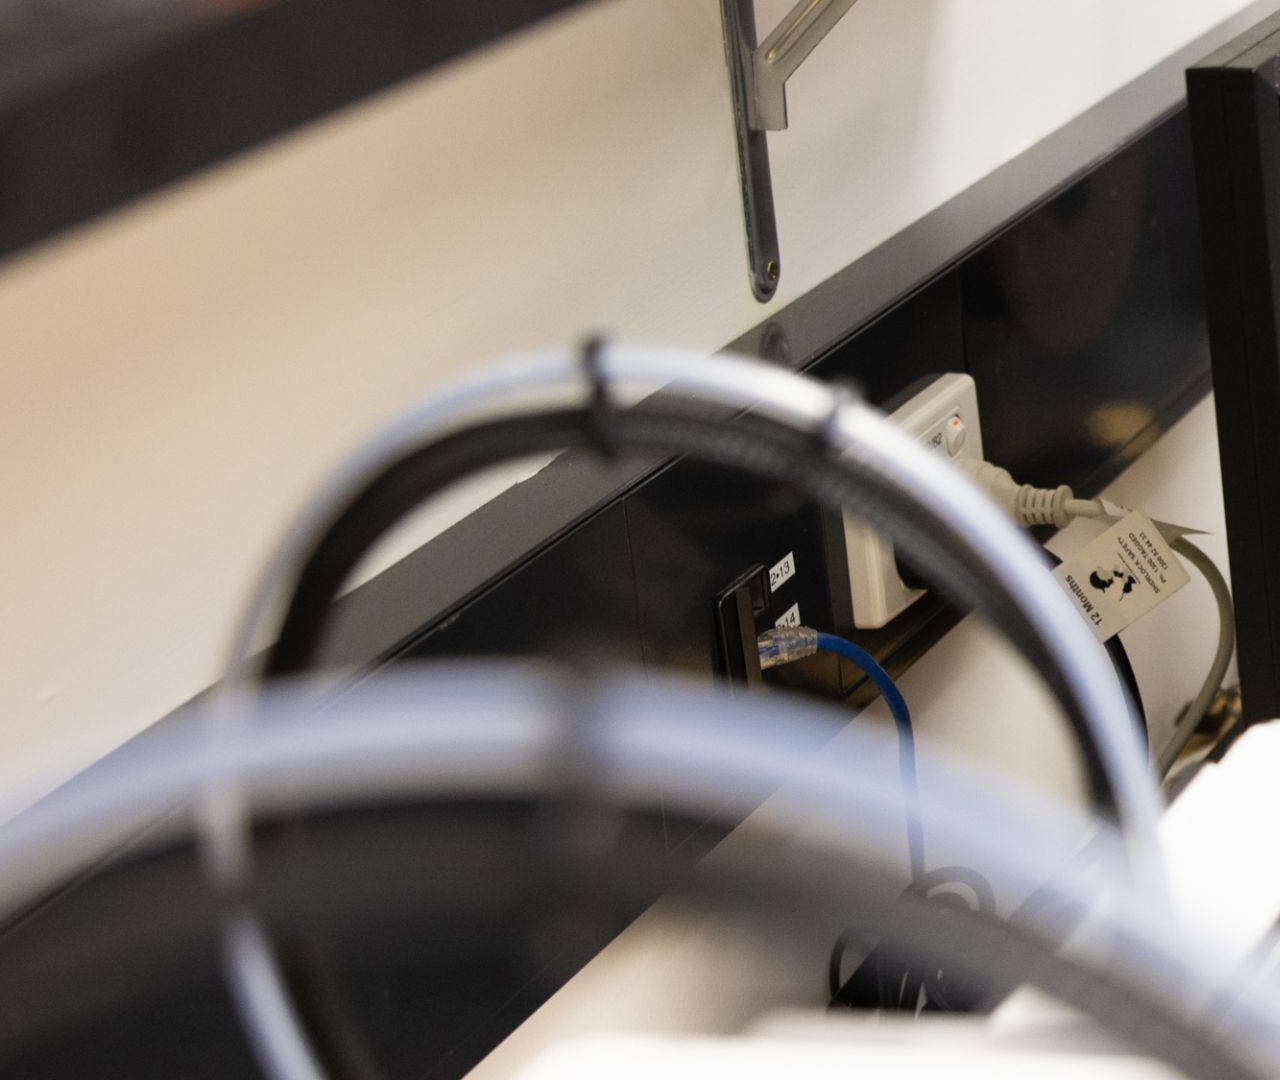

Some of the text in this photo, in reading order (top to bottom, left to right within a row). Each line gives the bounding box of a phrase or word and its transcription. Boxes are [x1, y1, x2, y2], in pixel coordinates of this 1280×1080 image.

[1116, 535, 1136, 560] SAFETY
[1127, 531, 1148, 559] TAGGED
[1134, 559, 1160, 594] SHERLOCK
[1064, 574, 1103, 626] 12 Months
